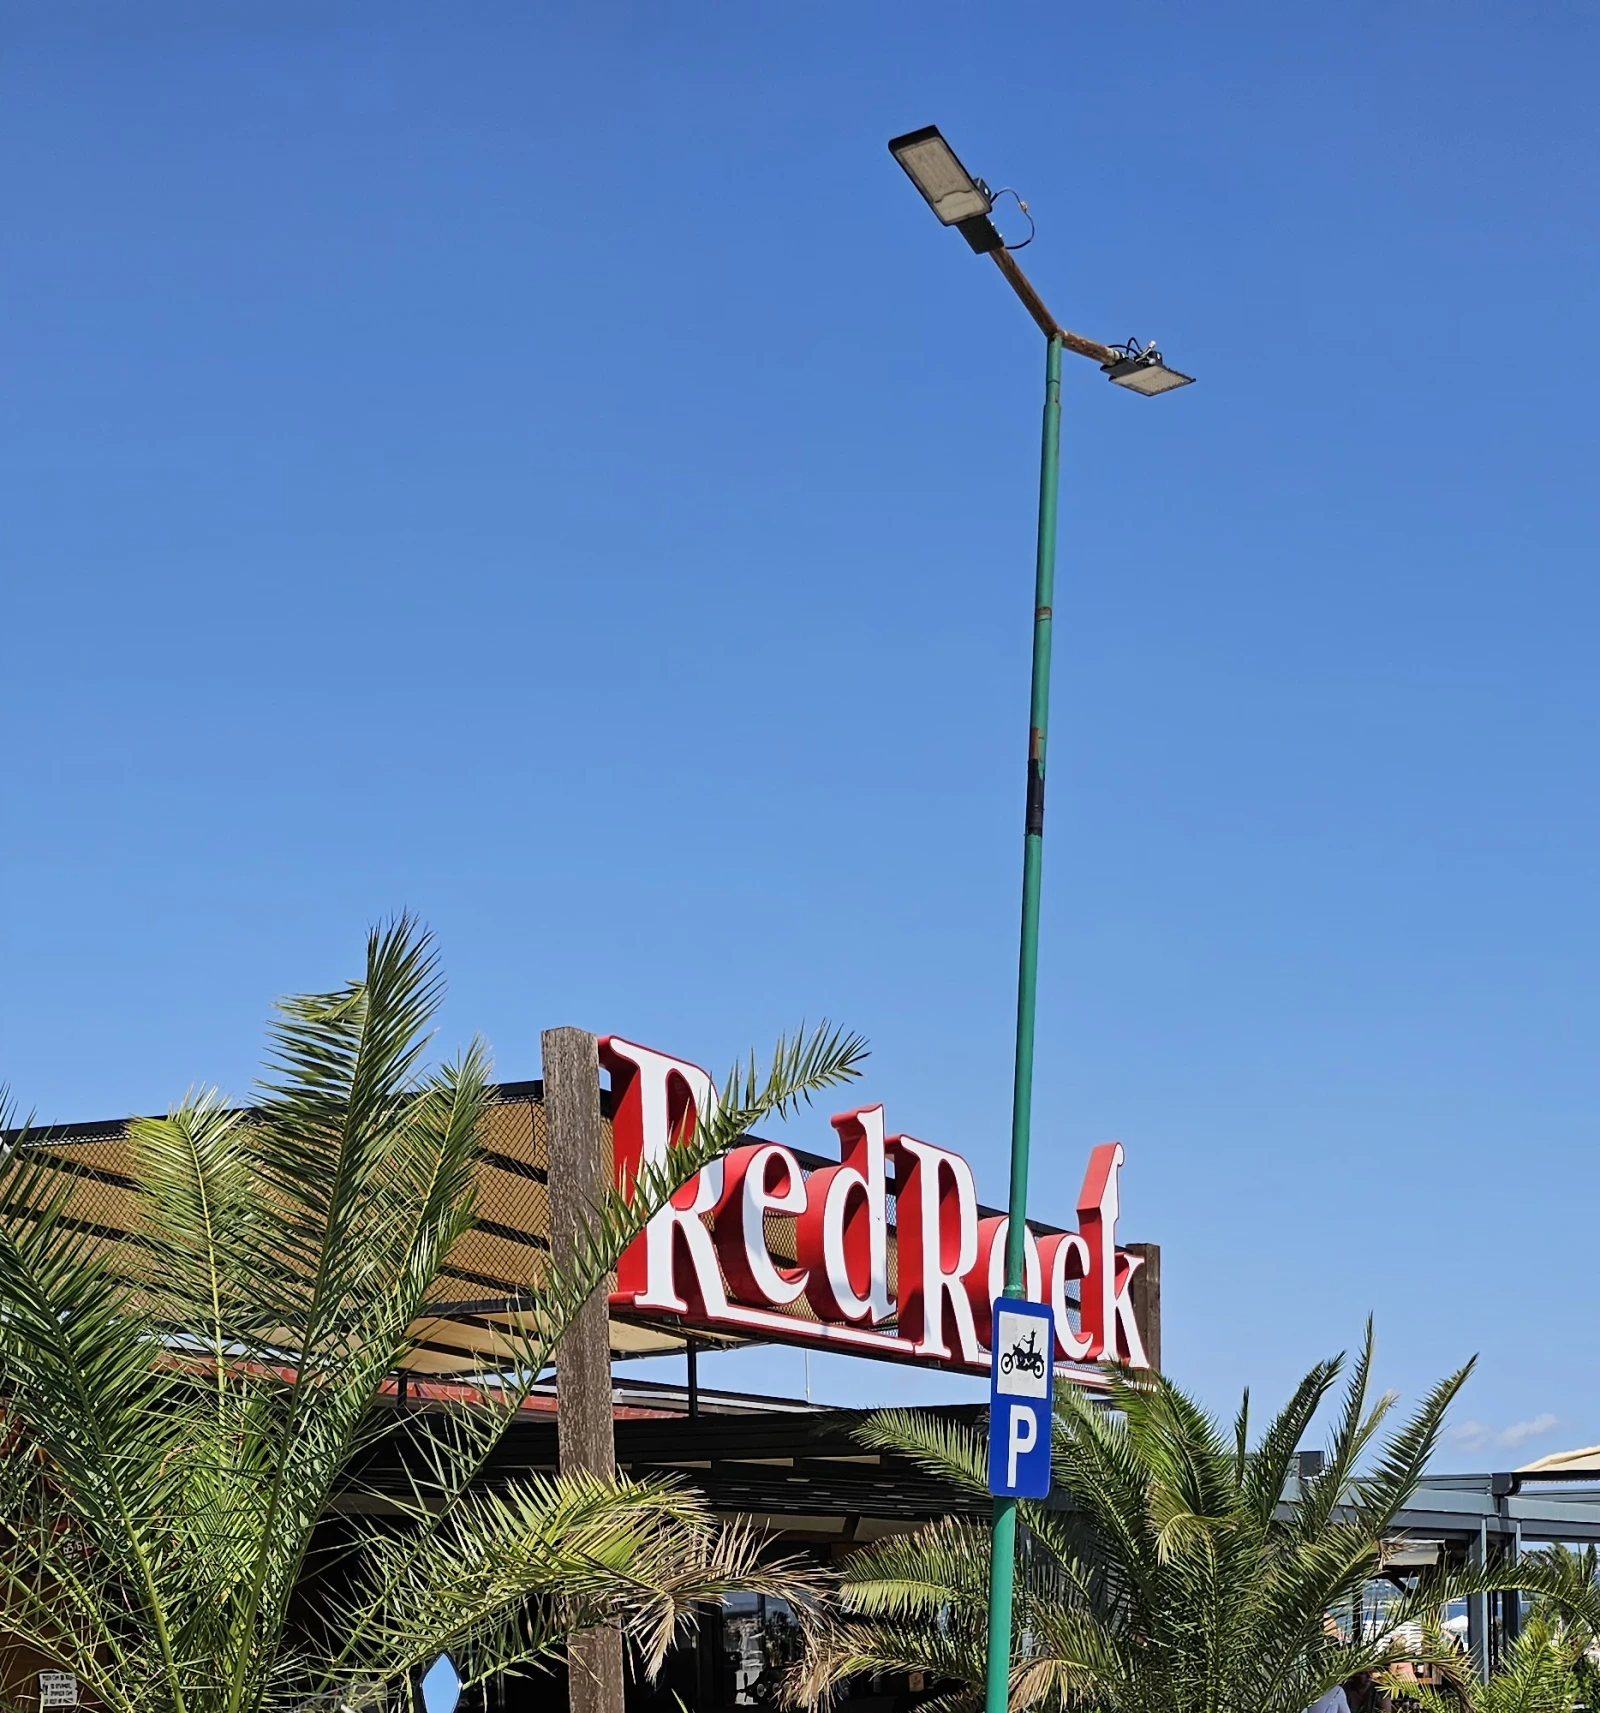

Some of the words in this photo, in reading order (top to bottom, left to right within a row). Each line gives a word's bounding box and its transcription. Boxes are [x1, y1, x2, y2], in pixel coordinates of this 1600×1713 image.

[598, 1036, 897, 1326] Red
[884, 1134, 1150, 1370] Rock
[1007, 1405, 1037, 1488] P
